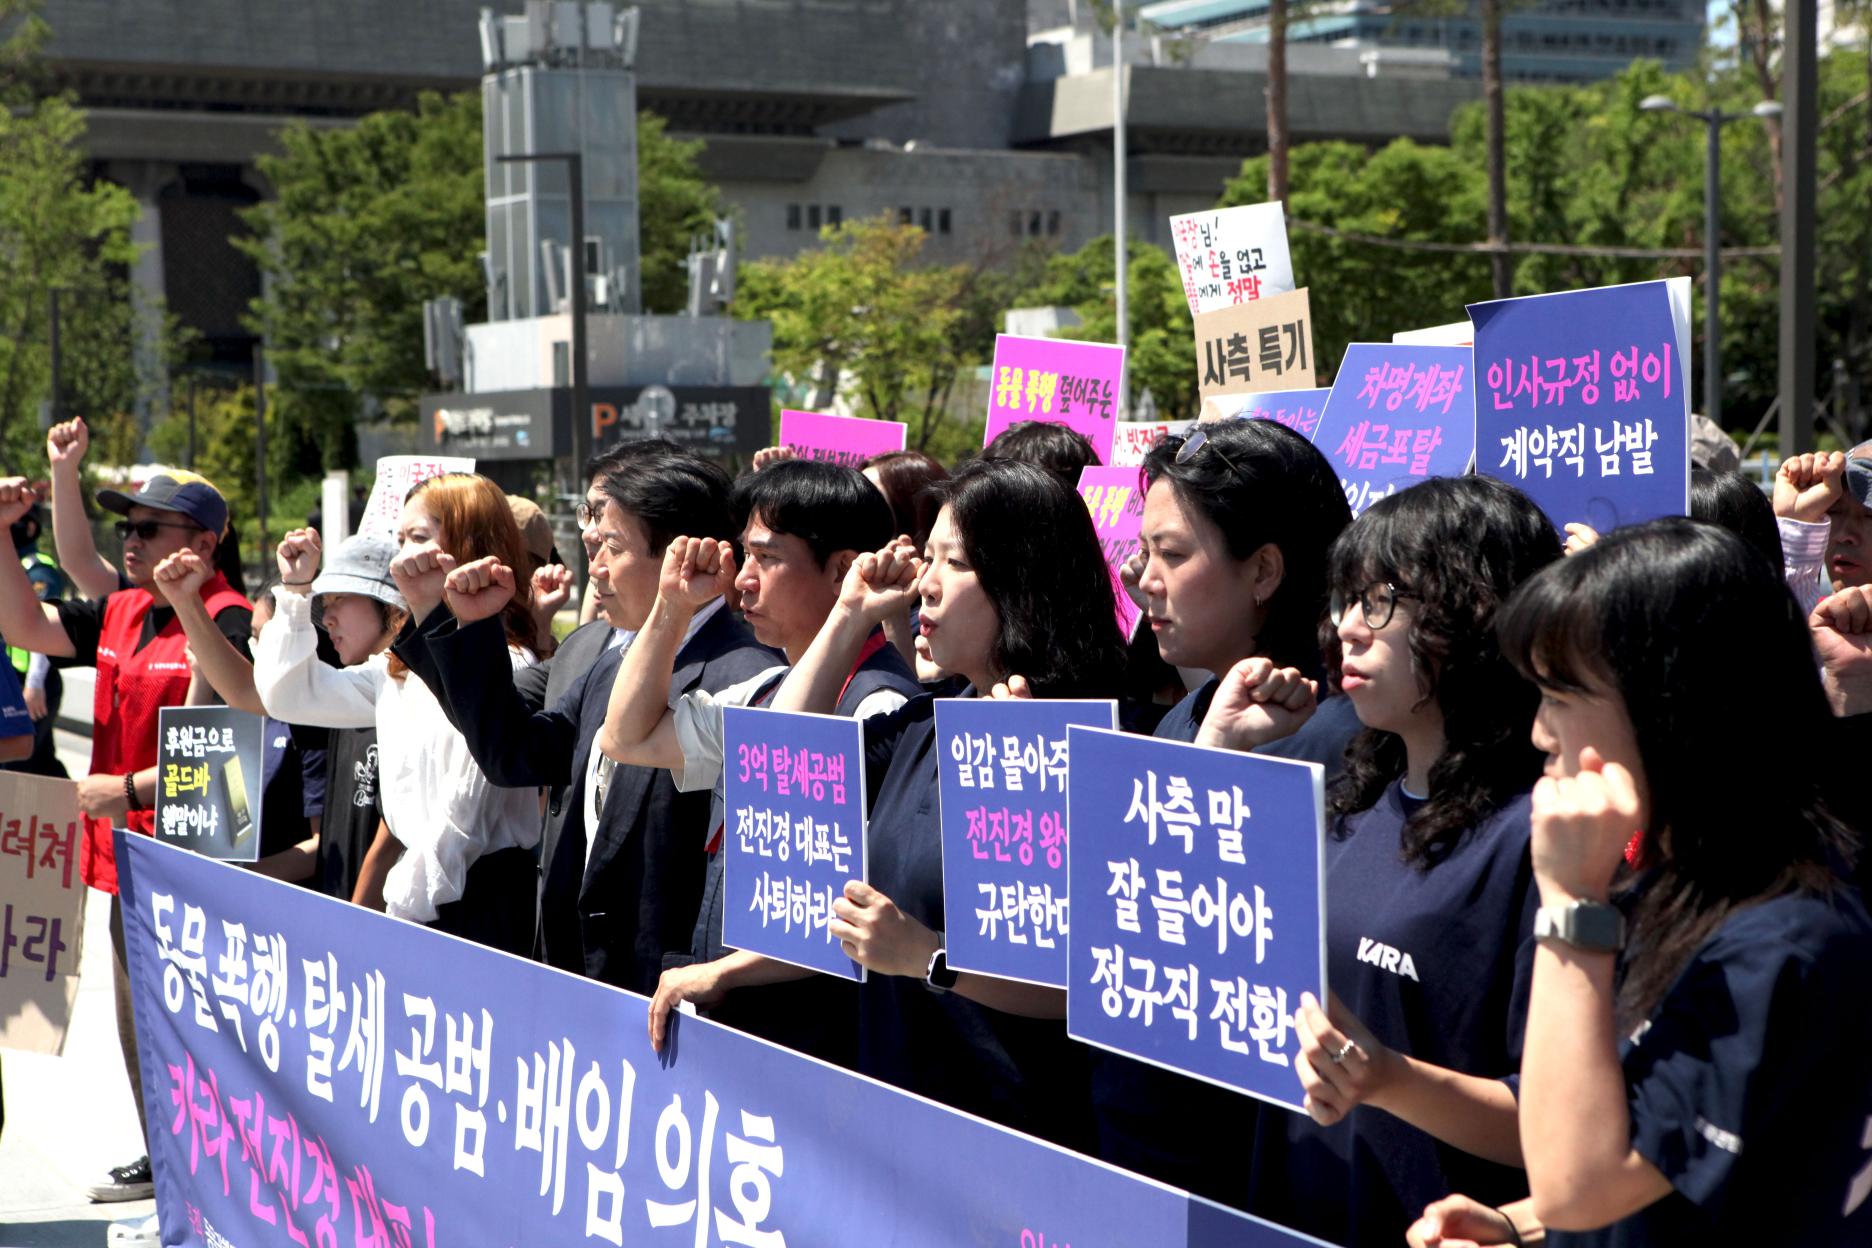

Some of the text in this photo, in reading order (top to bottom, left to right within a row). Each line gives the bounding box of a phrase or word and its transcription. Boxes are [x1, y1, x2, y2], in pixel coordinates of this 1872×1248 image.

[1208, 249, 1232, 280] 손을
[1226, 275, 1262, 304] 정말
[1204, 319, 1307, 387] 사측 특기
[1487, 342, 1671, 410] 인사규정 없이
[996, 366, 1113, 419] 동물 폭행 덮어주는
[1356, 361, 1464, 414] 차명계좌
[1334, 420, 1443, 476] 세금포탈
[1500, 418, 1659, 480] 계약직 남발
[164, 725, 236, 758] 후원금으로
[951, 732, 996, 789] 일감
[163, 761, 211, 798] 골드바
[738, 742, 846, 805] 3억 탈세공범
[735, 805, 852, 873] 전진경 대표는
[965, 806, 1033, 866] 전진경
[1123, 770, 1251, 864] 사측 말
[0, 812, 77, 889] 려쳐
[749, 871, 837, 944] 사퇴하라
[1106, 857, 1274, 965] 잘 들어야
[151, 890, 219, 1033] 동물
[1357, 936, 1420, 983] KARA
[1090, 944, 1295, 1067] 정규직 전환
[167, 1050, 235, 1198] 카라
